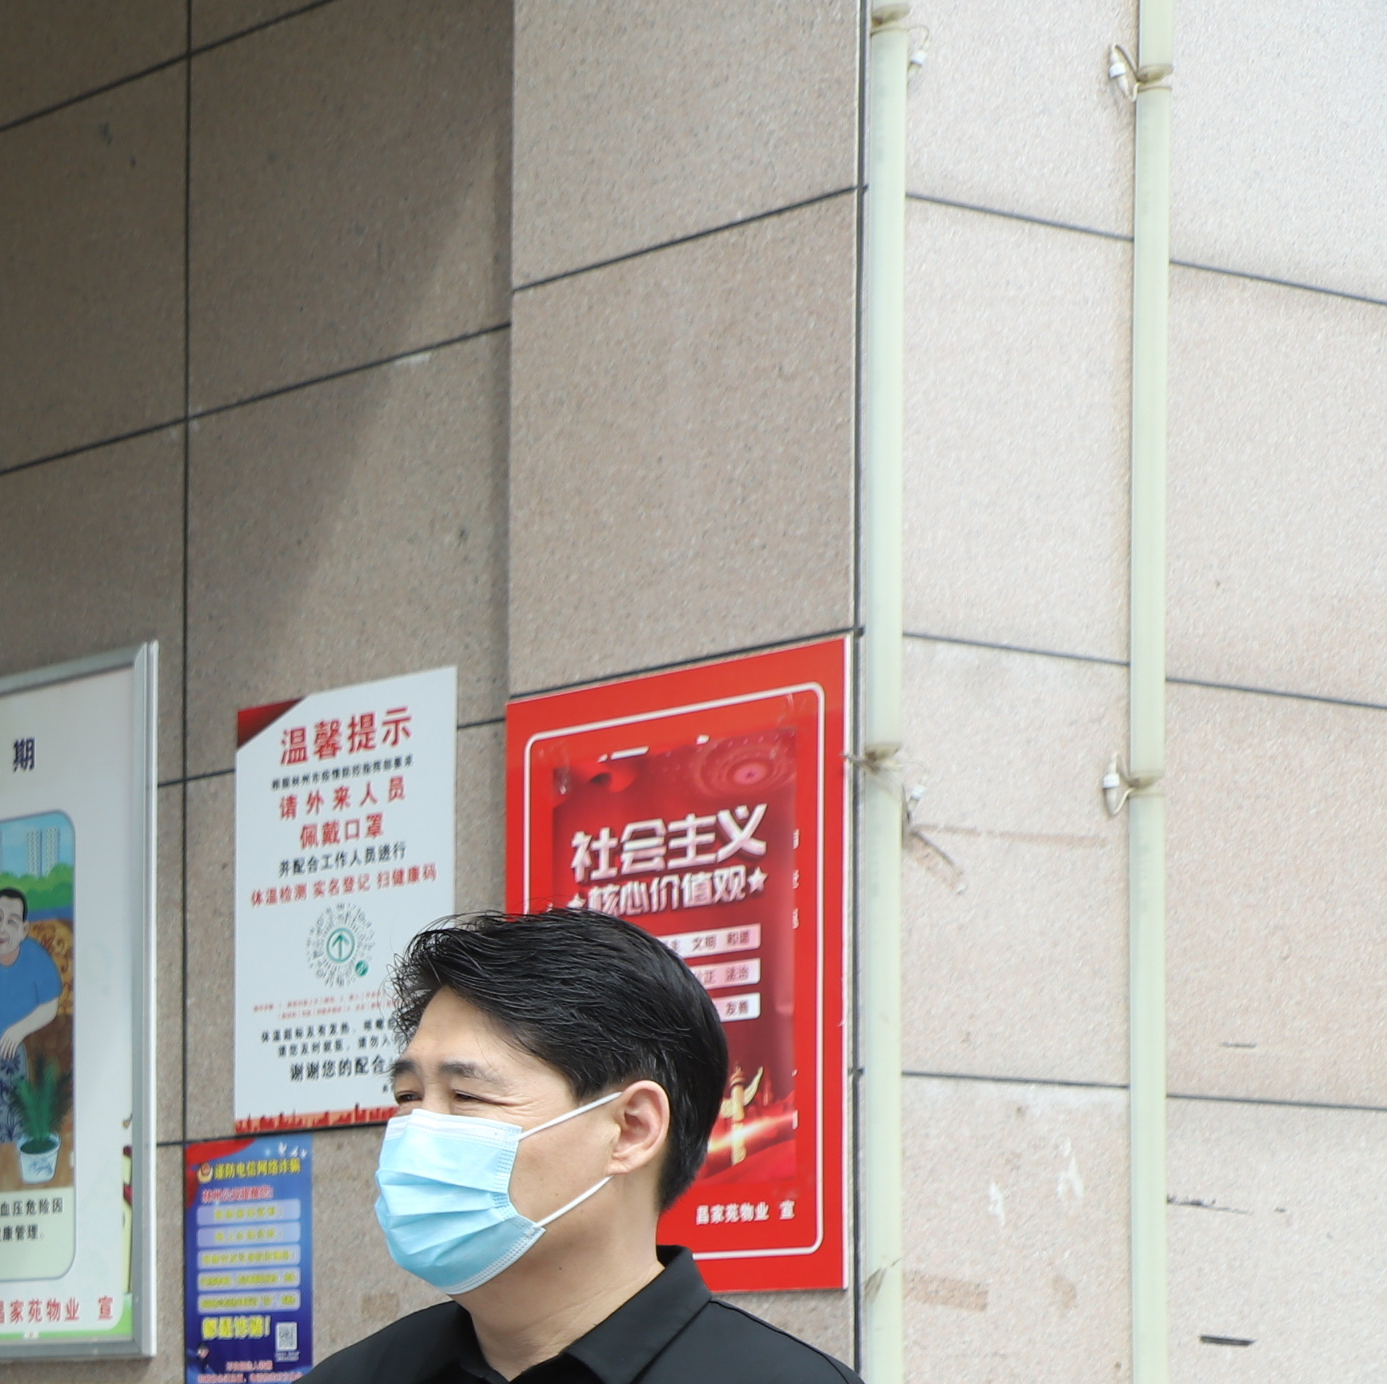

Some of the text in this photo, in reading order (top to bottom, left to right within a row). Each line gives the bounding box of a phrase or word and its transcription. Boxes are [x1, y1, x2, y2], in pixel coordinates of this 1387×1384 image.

[280, 707, 413, 766] 温馨提示
[279, 775, 406, 820] 请外来人员
[300, 812, 384, 850] 佩戴口罩
[570, 803, 768, 883] 社会主义
[278, 841, 407, 878] 并配合工作人员进行
[251, 863, 438, 908] 体温检测 实名登记 扫健康码
[588, 865, 747, 917] 核心价值观
[214, 1158, 301, 1181] 谨防电信网络诈骗
[695, 1200, 796, 1226] 昌家苑物业 宣
[98, 1296, 114, 1321] 宣
